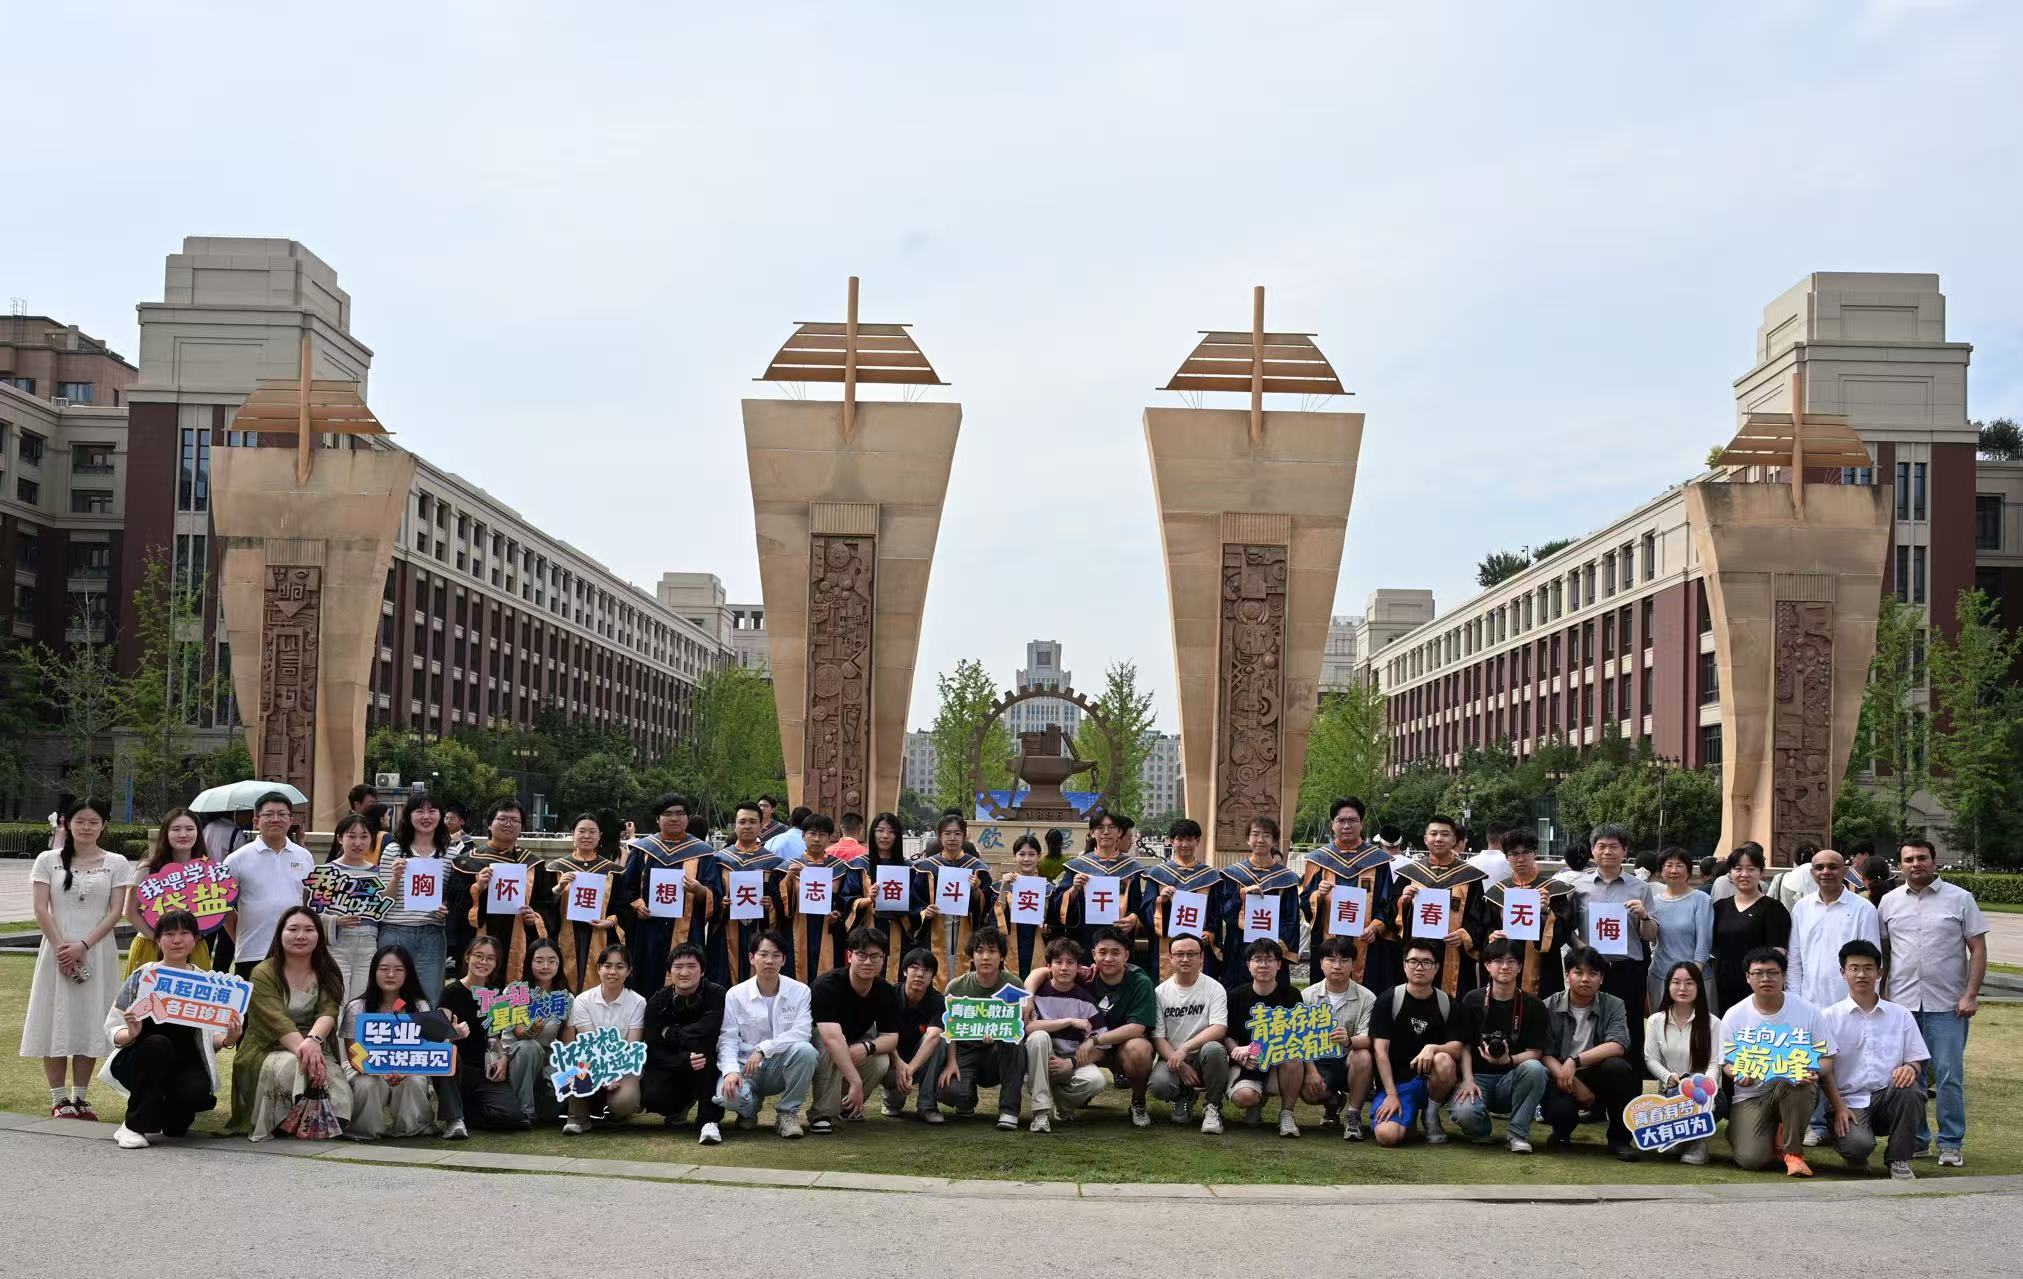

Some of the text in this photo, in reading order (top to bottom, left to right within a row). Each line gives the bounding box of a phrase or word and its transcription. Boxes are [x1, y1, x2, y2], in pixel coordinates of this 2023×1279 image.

[139, 862, 231, 900] 我喂学校
[412, 873, 436, 897] 胸
[495, 878, 519, 902] 怀
[805, 880, 827, 902] 志
[882, 879, 904, 901] 奋
[943, 881, 964, 902] 斗
[575, 886, 597, 909] 理
[655, 882, 678, 905] 想
[736, 885, 758, 907] 矢
[1018, 890, 1040, 912] 实
[1092, 891, 1113, 912] 干
[1176, 905, 1199, 928] 担
[1250, 909, 1273, 931] 当
[1337, 900, 1360, 924] 青
[1420, 902, 1443, 926] 春
[1510, 904, 1534, 927] 无
[1596, 917, 1621, 941] 悔
[154, 976, 232, 1005] 风起四海
[475, 985, 530, 1014] 下一站
[166, 1000, 232, 1023] 各自珍重
[492, 993, 566, 1034] 星辰大海
[364, 1021, 421, 1045] 毕业
[955, 1022, 1013, 1037] 毕业快乐
[1736, 1026, 1811, 1048] 走向人生
[367, 1050, 449, 1068] 不说再见
[1260, 1029, 1342, 1070] 后会有期
[1731, 1044, 1812, 1081] 巅峰
[1633, 1099, 1694, 1127] 青春有梦
[1641, 1116, 1708, 1146] 大有可为
